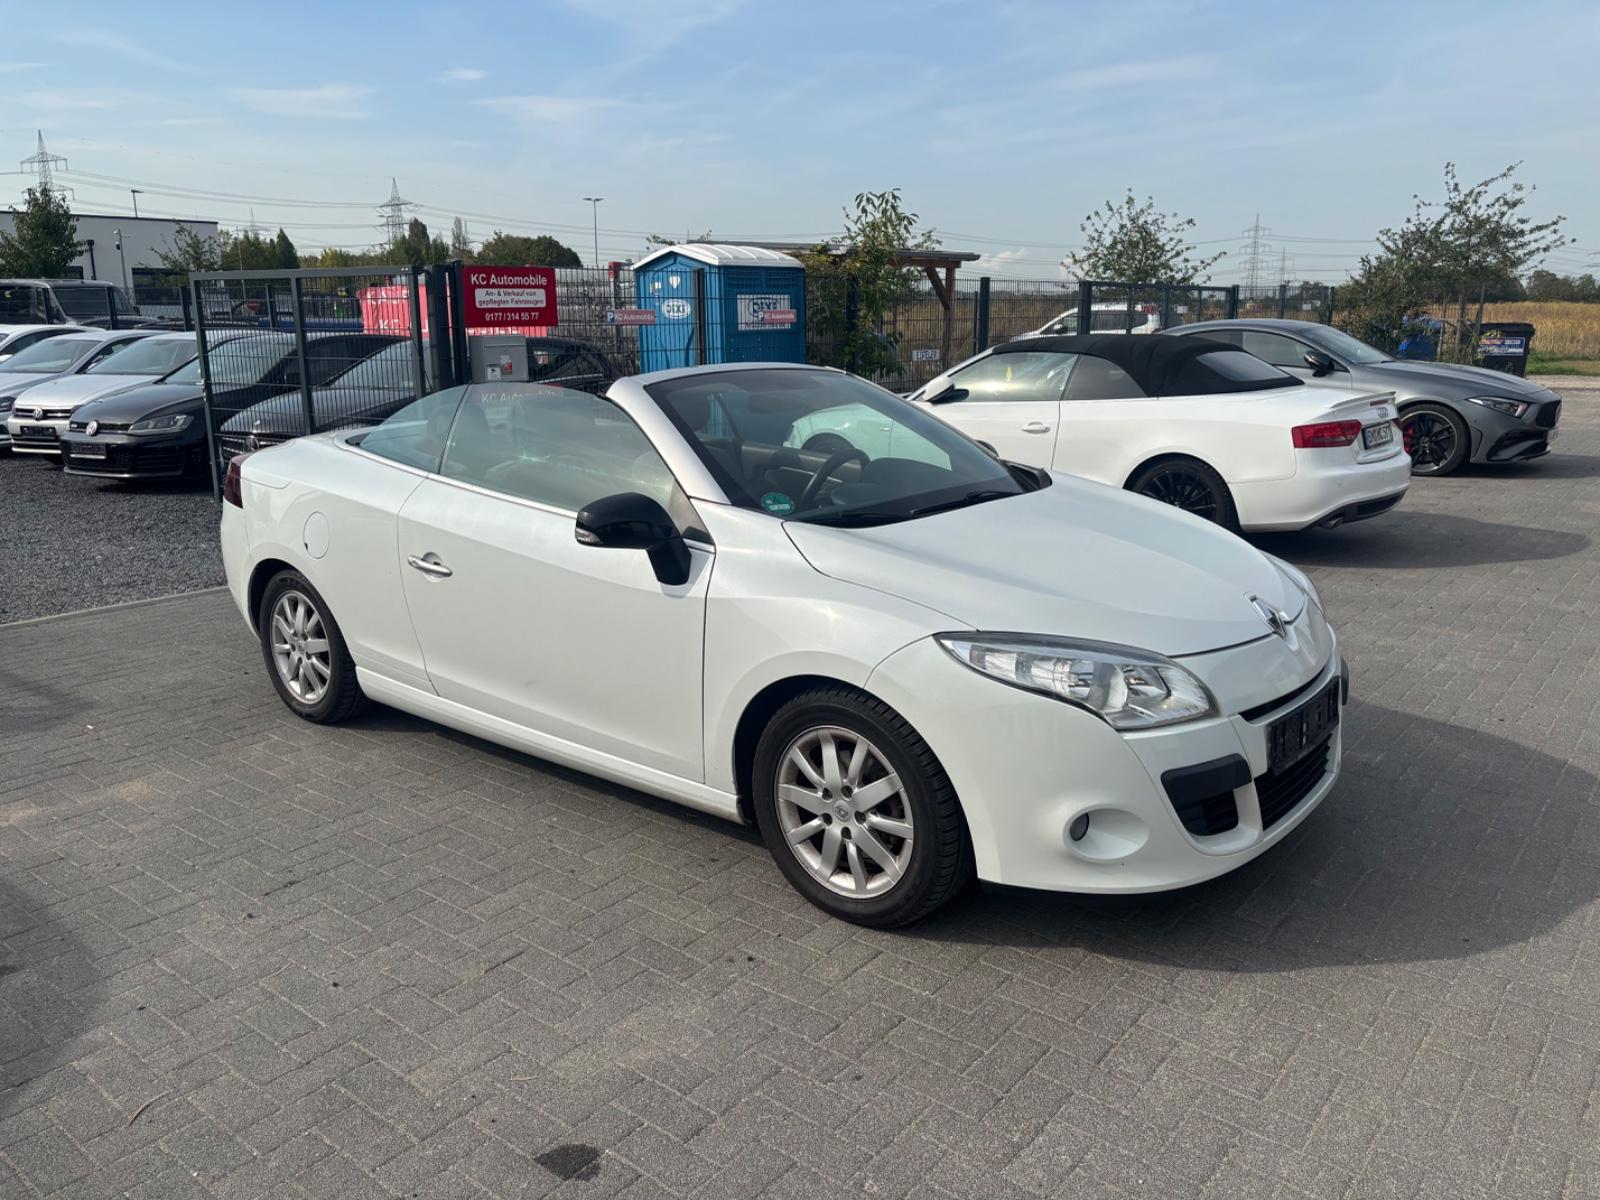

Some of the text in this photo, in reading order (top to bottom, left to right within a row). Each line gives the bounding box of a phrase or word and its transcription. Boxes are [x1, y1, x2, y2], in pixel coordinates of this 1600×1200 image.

[470, 273, 548, 286] KC Automobile
[484, 289, 496, 297] An-
[502, 289, 526, 297] Verkauf
[478, 298, 544, 307] gepflegten Fahrzeugen
[520, 312, 530, 321] 55
[530, 312, 540, 320] 77
[606, 311, 614, 323] P
[757, 311, 764, 320] P
